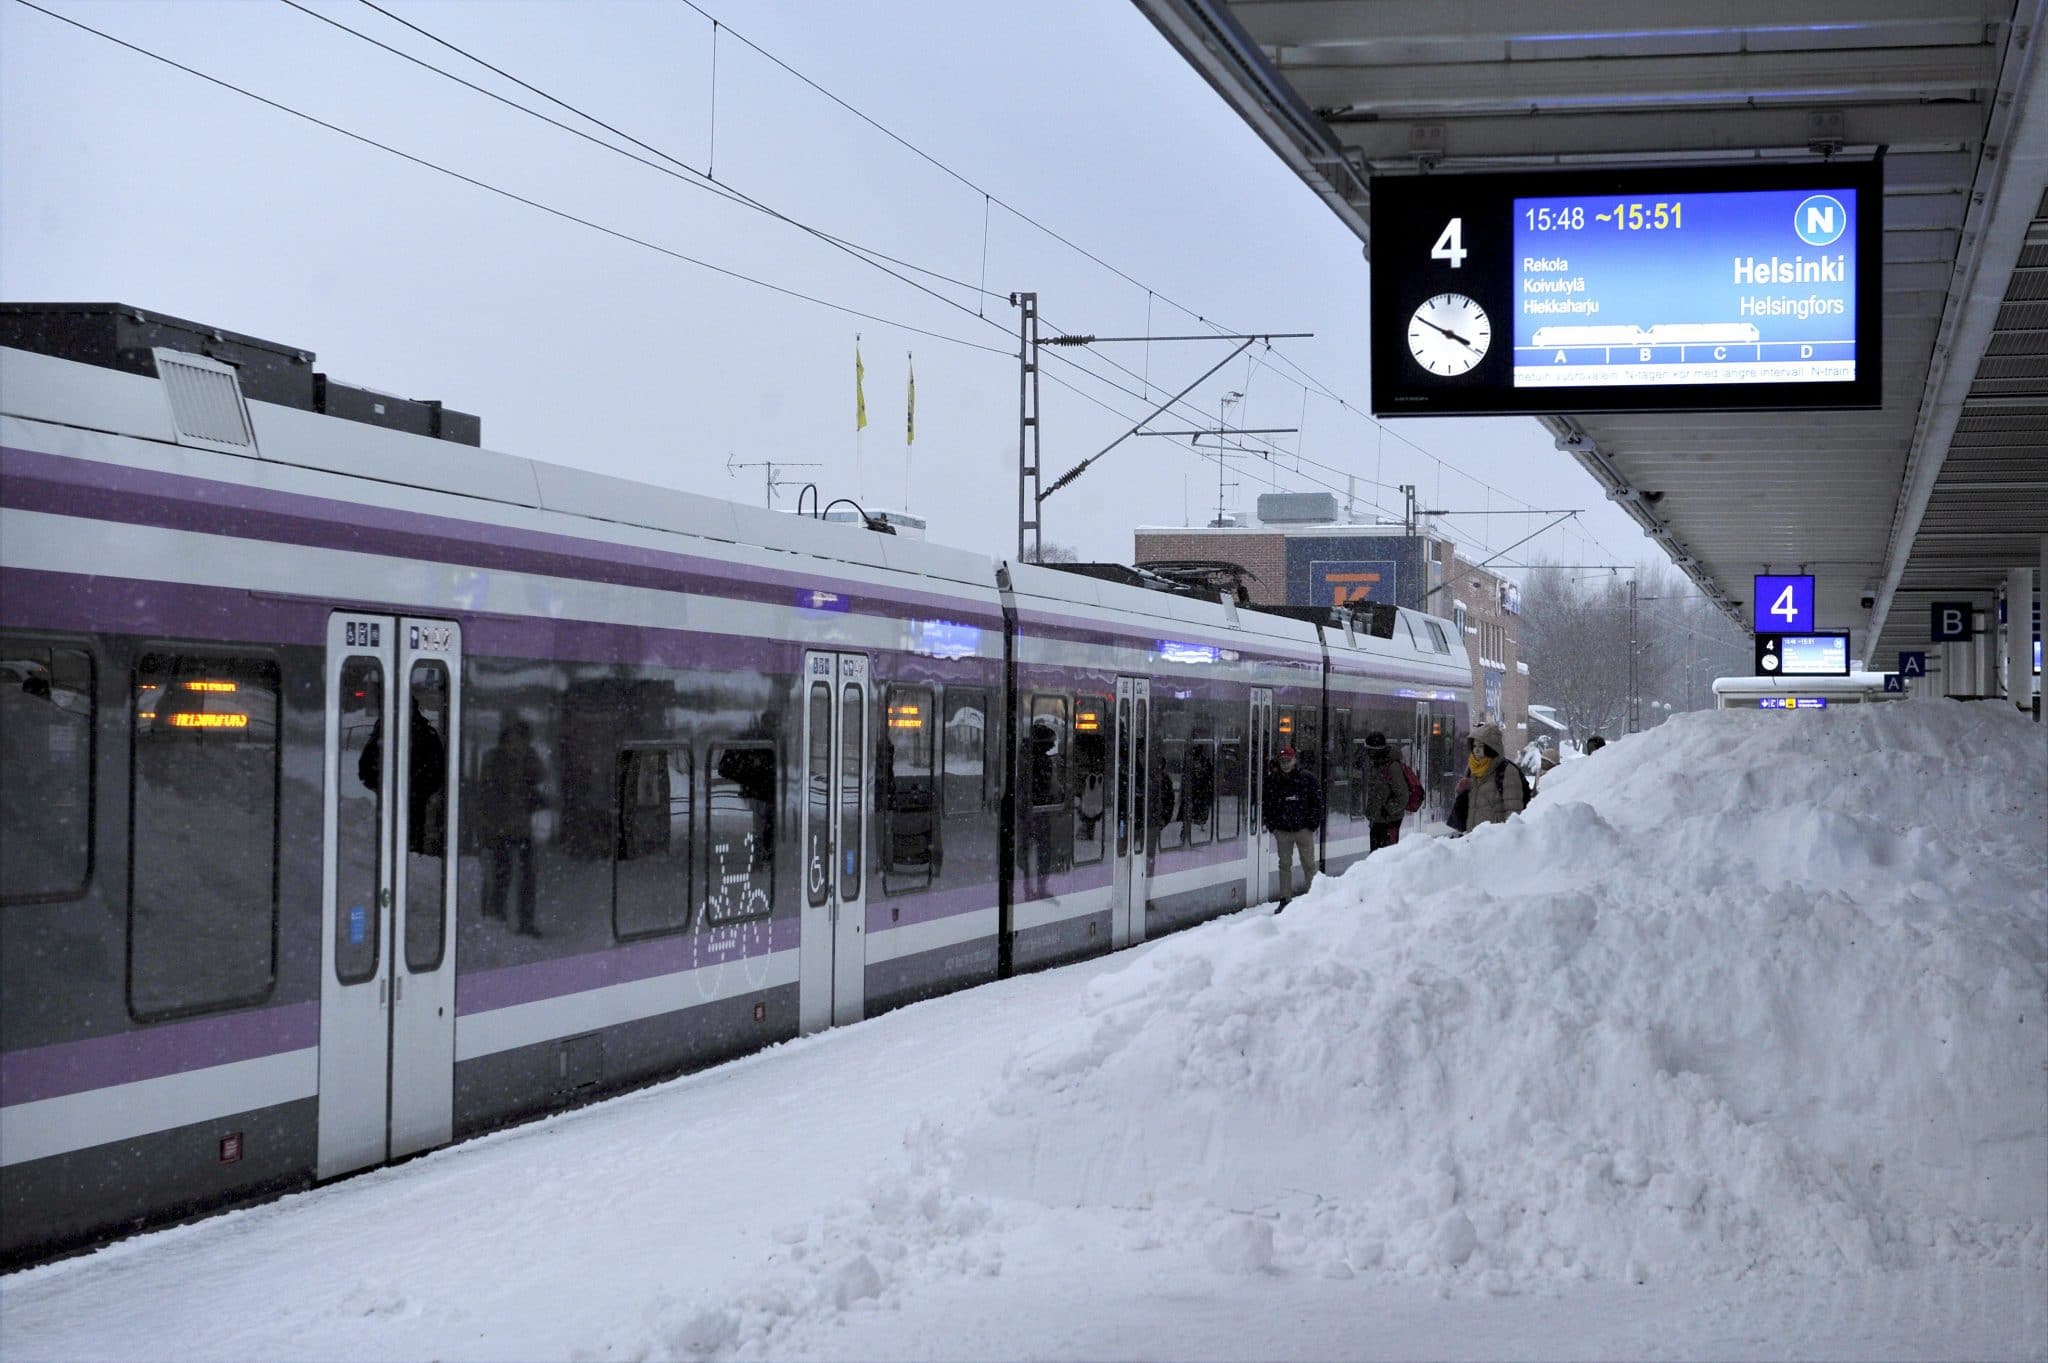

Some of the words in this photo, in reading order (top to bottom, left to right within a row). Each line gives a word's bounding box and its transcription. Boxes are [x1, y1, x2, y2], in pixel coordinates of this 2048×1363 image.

[1525, 206, 1585, 231] 15:48
[1807, 206, 1834, 234] N
[1430, 217, 1468, 269] 4
[1523, 257, 1568, 273] Rekola
[1733, 254, 1845, 285] Helsinki
[1523, 277, 1585, 295] Koivukylä
[1523, 298, 1600, 316] Hiekkaharju
[1740, 294, 1845, 320] Helsingfors
[1554, 349, 1567, 364] A
[1639, 347, 1652, 362] B
[1713, 346, 1727, 361] C
[1801, 345, 1813, 359] D
[1770, 584, 1799, 624] 4
[1942, 610, 1963, 635] B
[1766, 639, 1774, 650] 4
[1904, 656, 1920, 673] A
[1888, 678, 1900, 690] A
